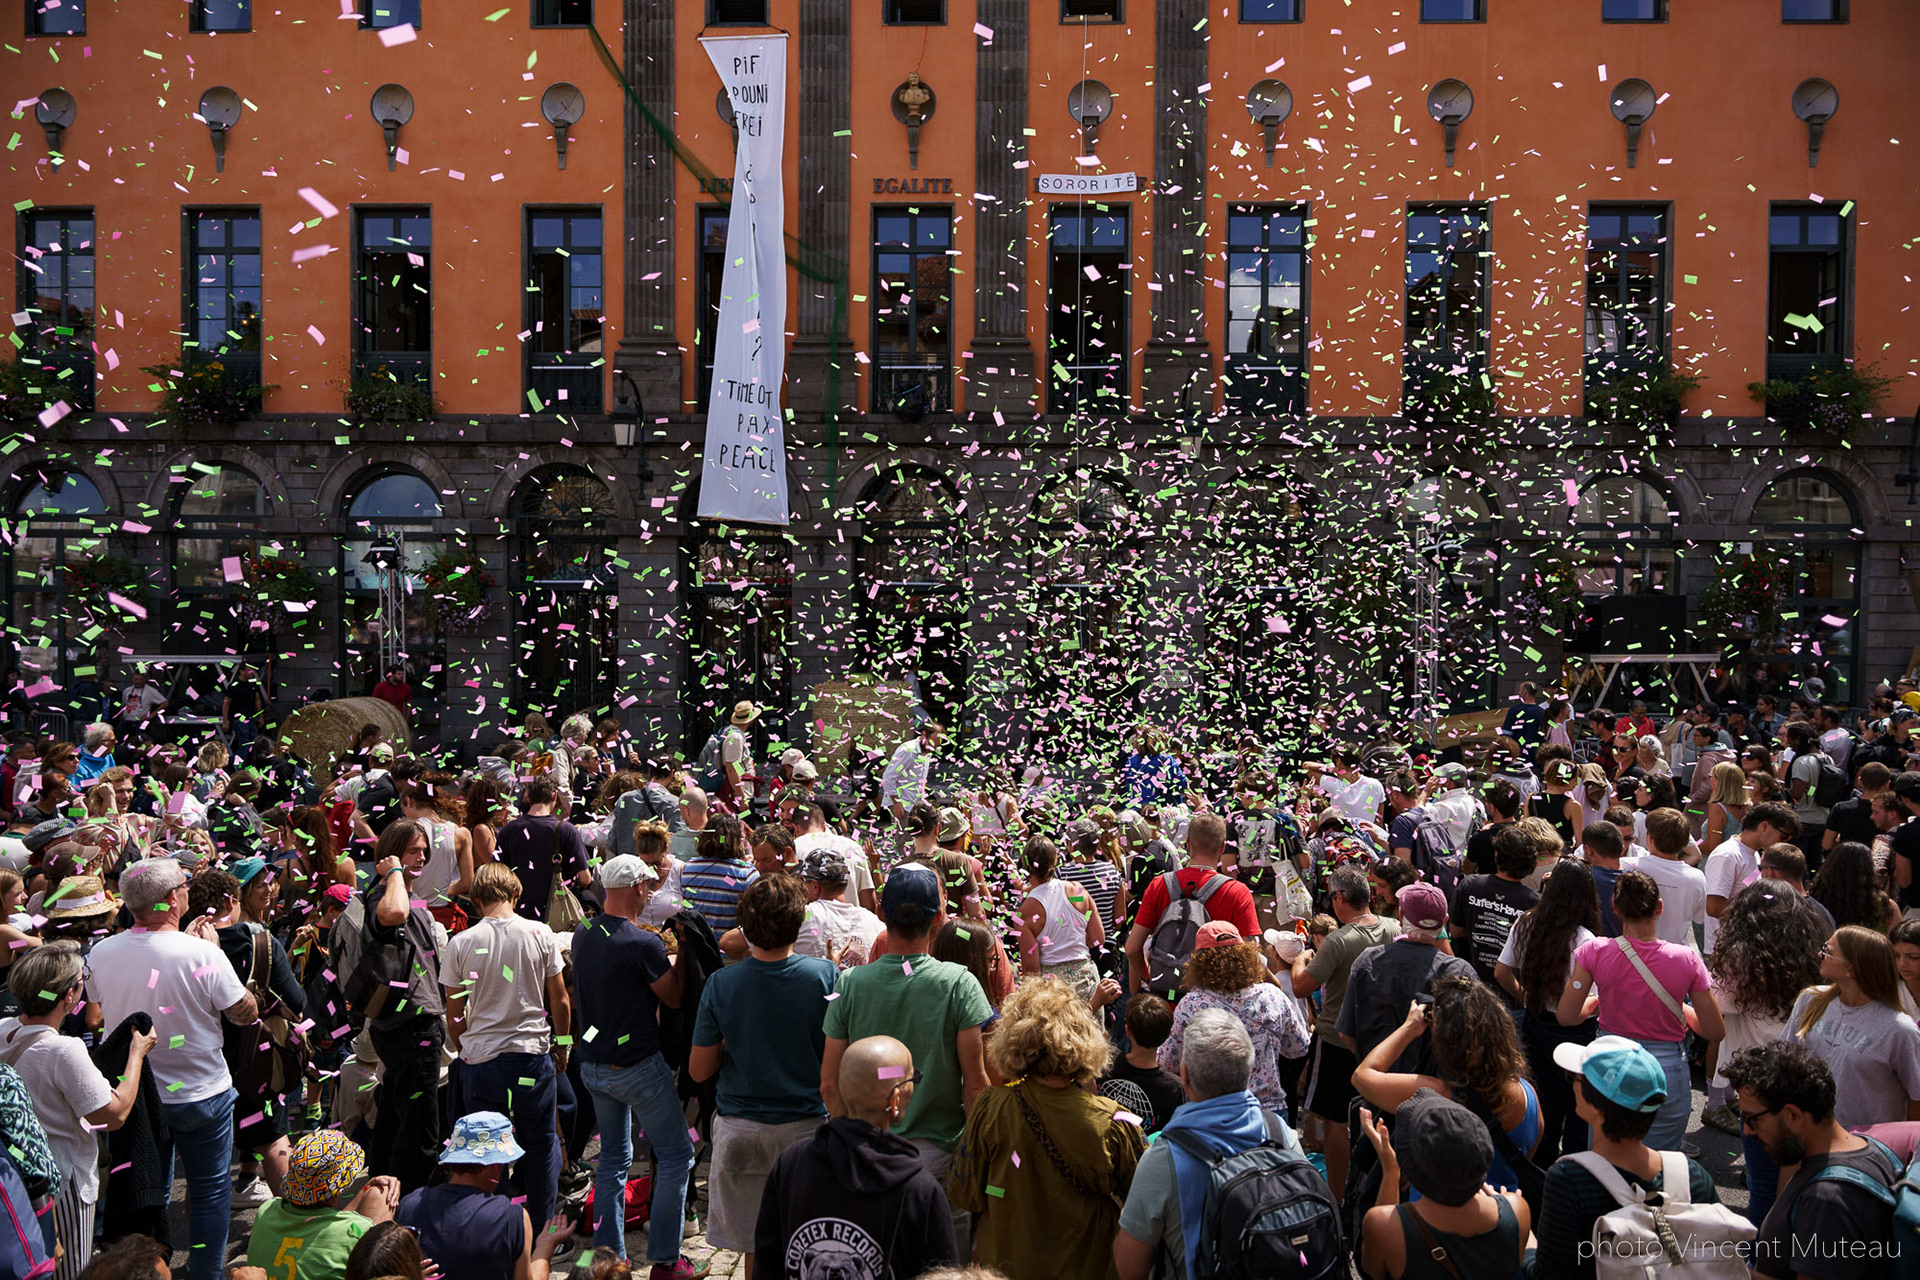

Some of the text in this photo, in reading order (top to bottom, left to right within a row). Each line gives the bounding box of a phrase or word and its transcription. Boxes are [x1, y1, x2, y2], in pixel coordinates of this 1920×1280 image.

[873, 178, 953, 194] EGALITE
[1041, 174, 1135, 190] SORORITÉ
[738, 413, 770, 435] PAX
[720, 444, 776, 473] PEACE
[268, 1236, 304, 1280] 5
[787, 1222, 884, 1277] CORETEX RECORDS
